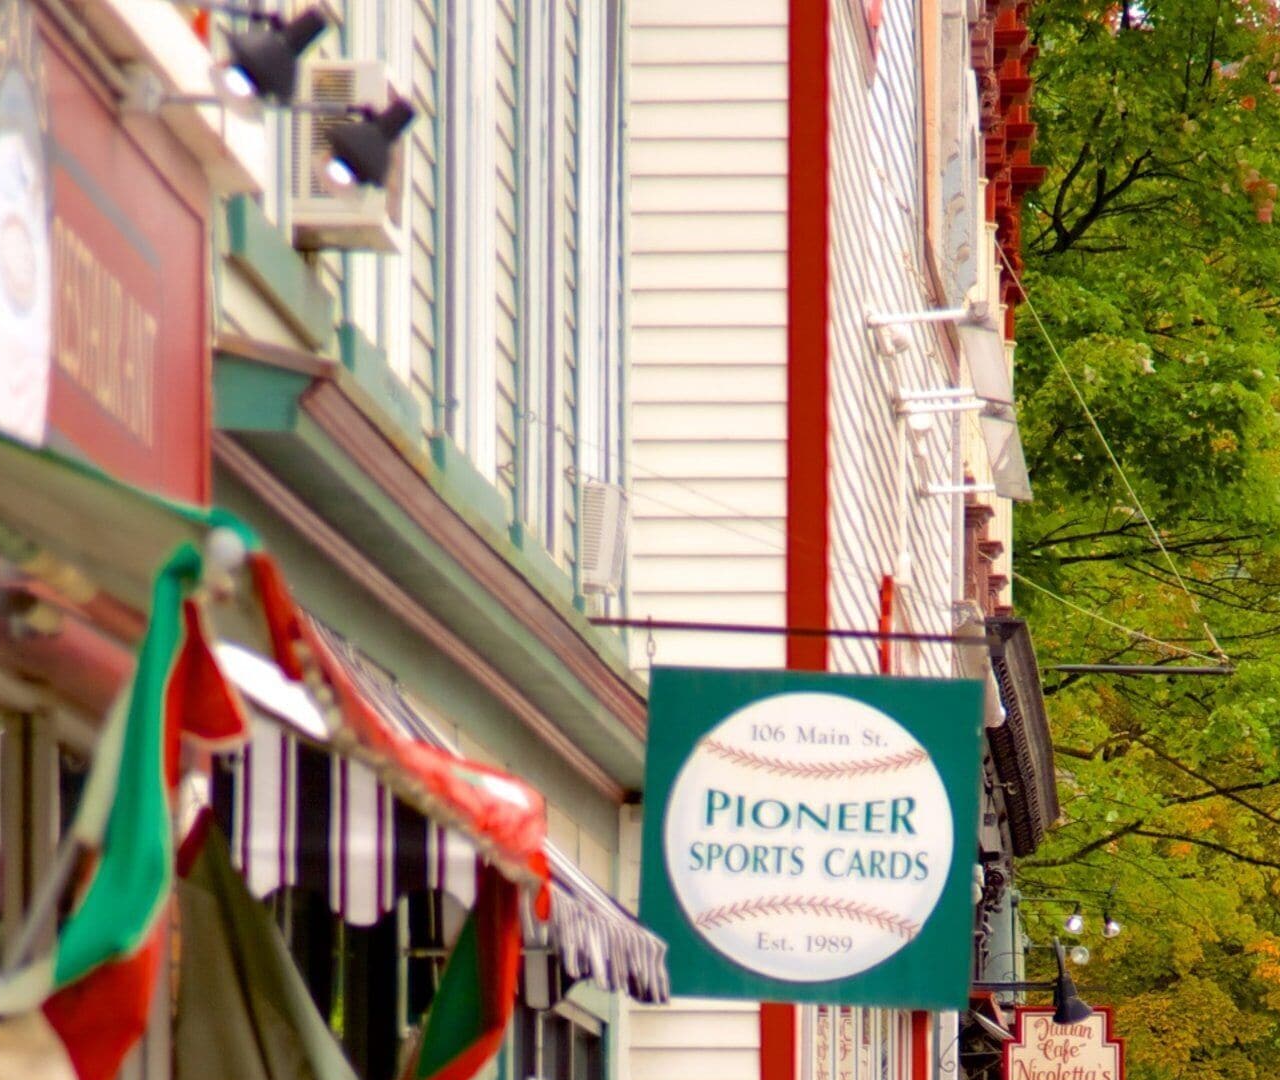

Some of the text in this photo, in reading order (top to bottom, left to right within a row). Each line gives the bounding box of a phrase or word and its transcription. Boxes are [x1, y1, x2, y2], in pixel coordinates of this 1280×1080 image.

[751, 724, 888, 747] 106 Main St.
[706, 788, 918, 835] PIONEER
[689, 841, 929, 881] SPORTS CARDS
[757, 931, 853, 953] Est. 1989
